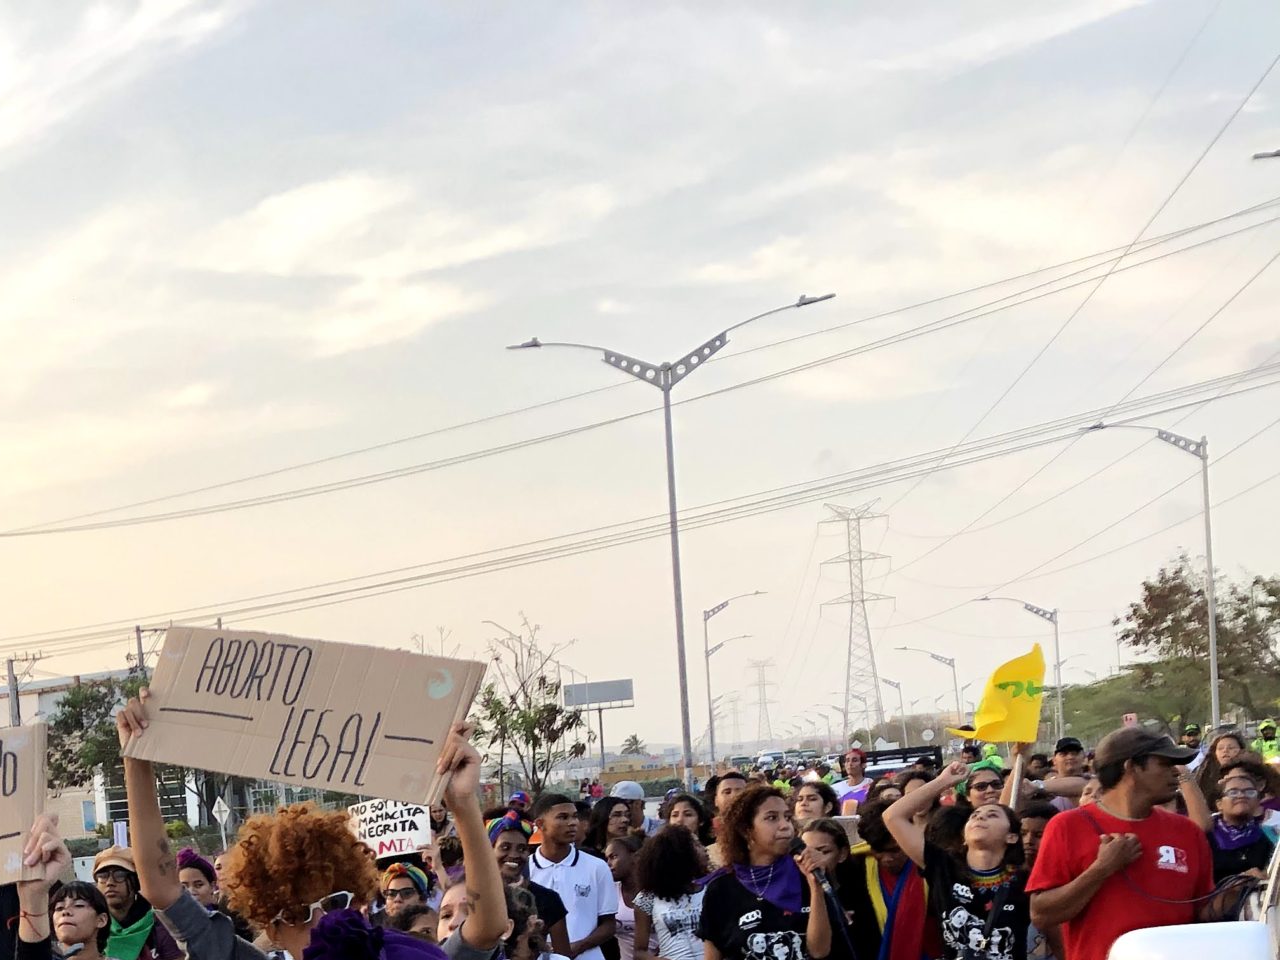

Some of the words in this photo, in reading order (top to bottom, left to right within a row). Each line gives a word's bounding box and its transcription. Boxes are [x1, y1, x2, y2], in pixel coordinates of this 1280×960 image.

[195, 637, 313, 706] ABORTO
[269, 706, 381, 787] LEGAL
[351, 804, 367, 817] NO
[370, 800, 388, 813] SOY
[359, 807, 425, 829] MAMACITA
[358, 820, 419, 841] NEGRITA
